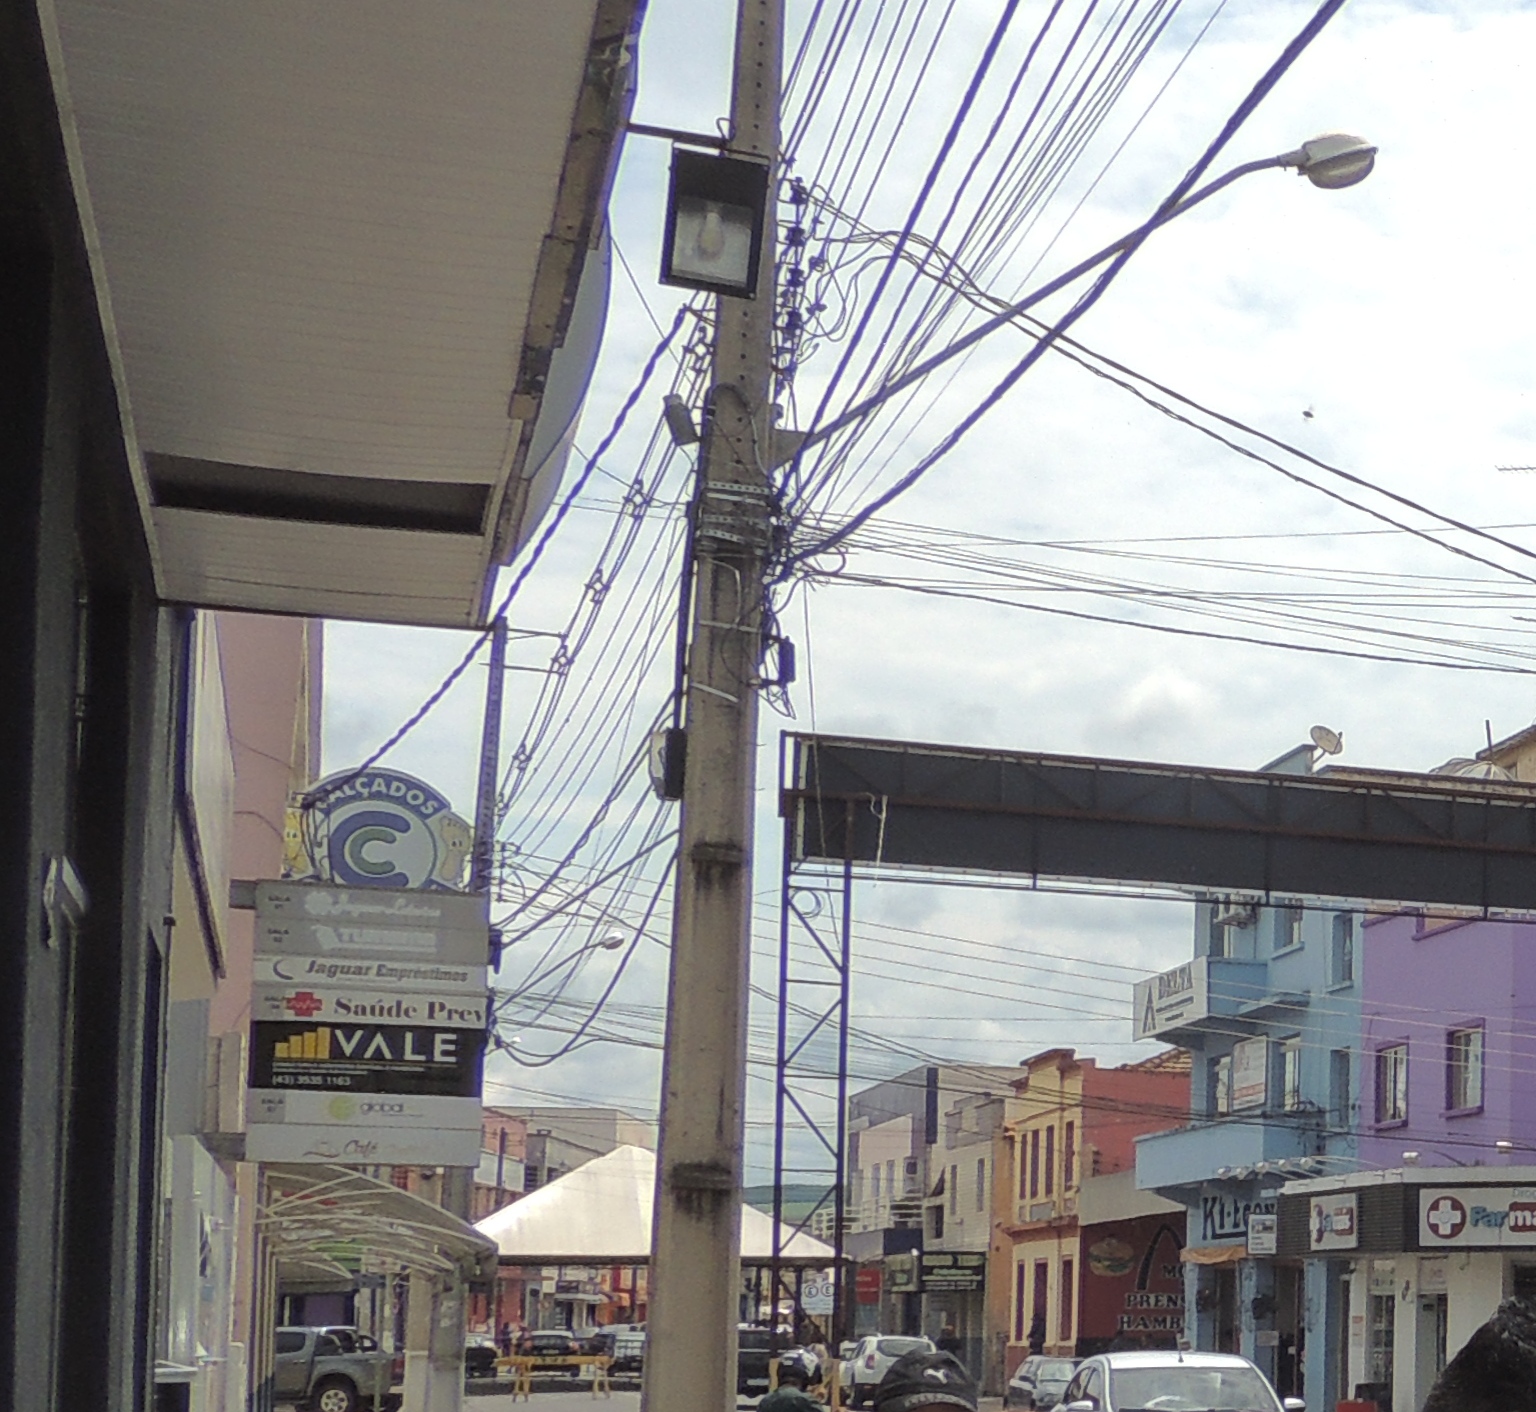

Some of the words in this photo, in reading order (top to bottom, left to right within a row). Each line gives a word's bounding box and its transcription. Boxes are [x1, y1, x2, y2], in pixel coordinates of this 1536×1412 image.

[317, 777, 439, 815] ALÇADOS
[305, 960, 373, 978] Jaguar
[375, 964, 469, 982] Empréstimos
[334, 997, 418, 1019] Saúde
[426, 1001, 483, 1023] Prev
[334, 1028, 458, 1063] VALE
[360, 1102, 404, 1116] global
